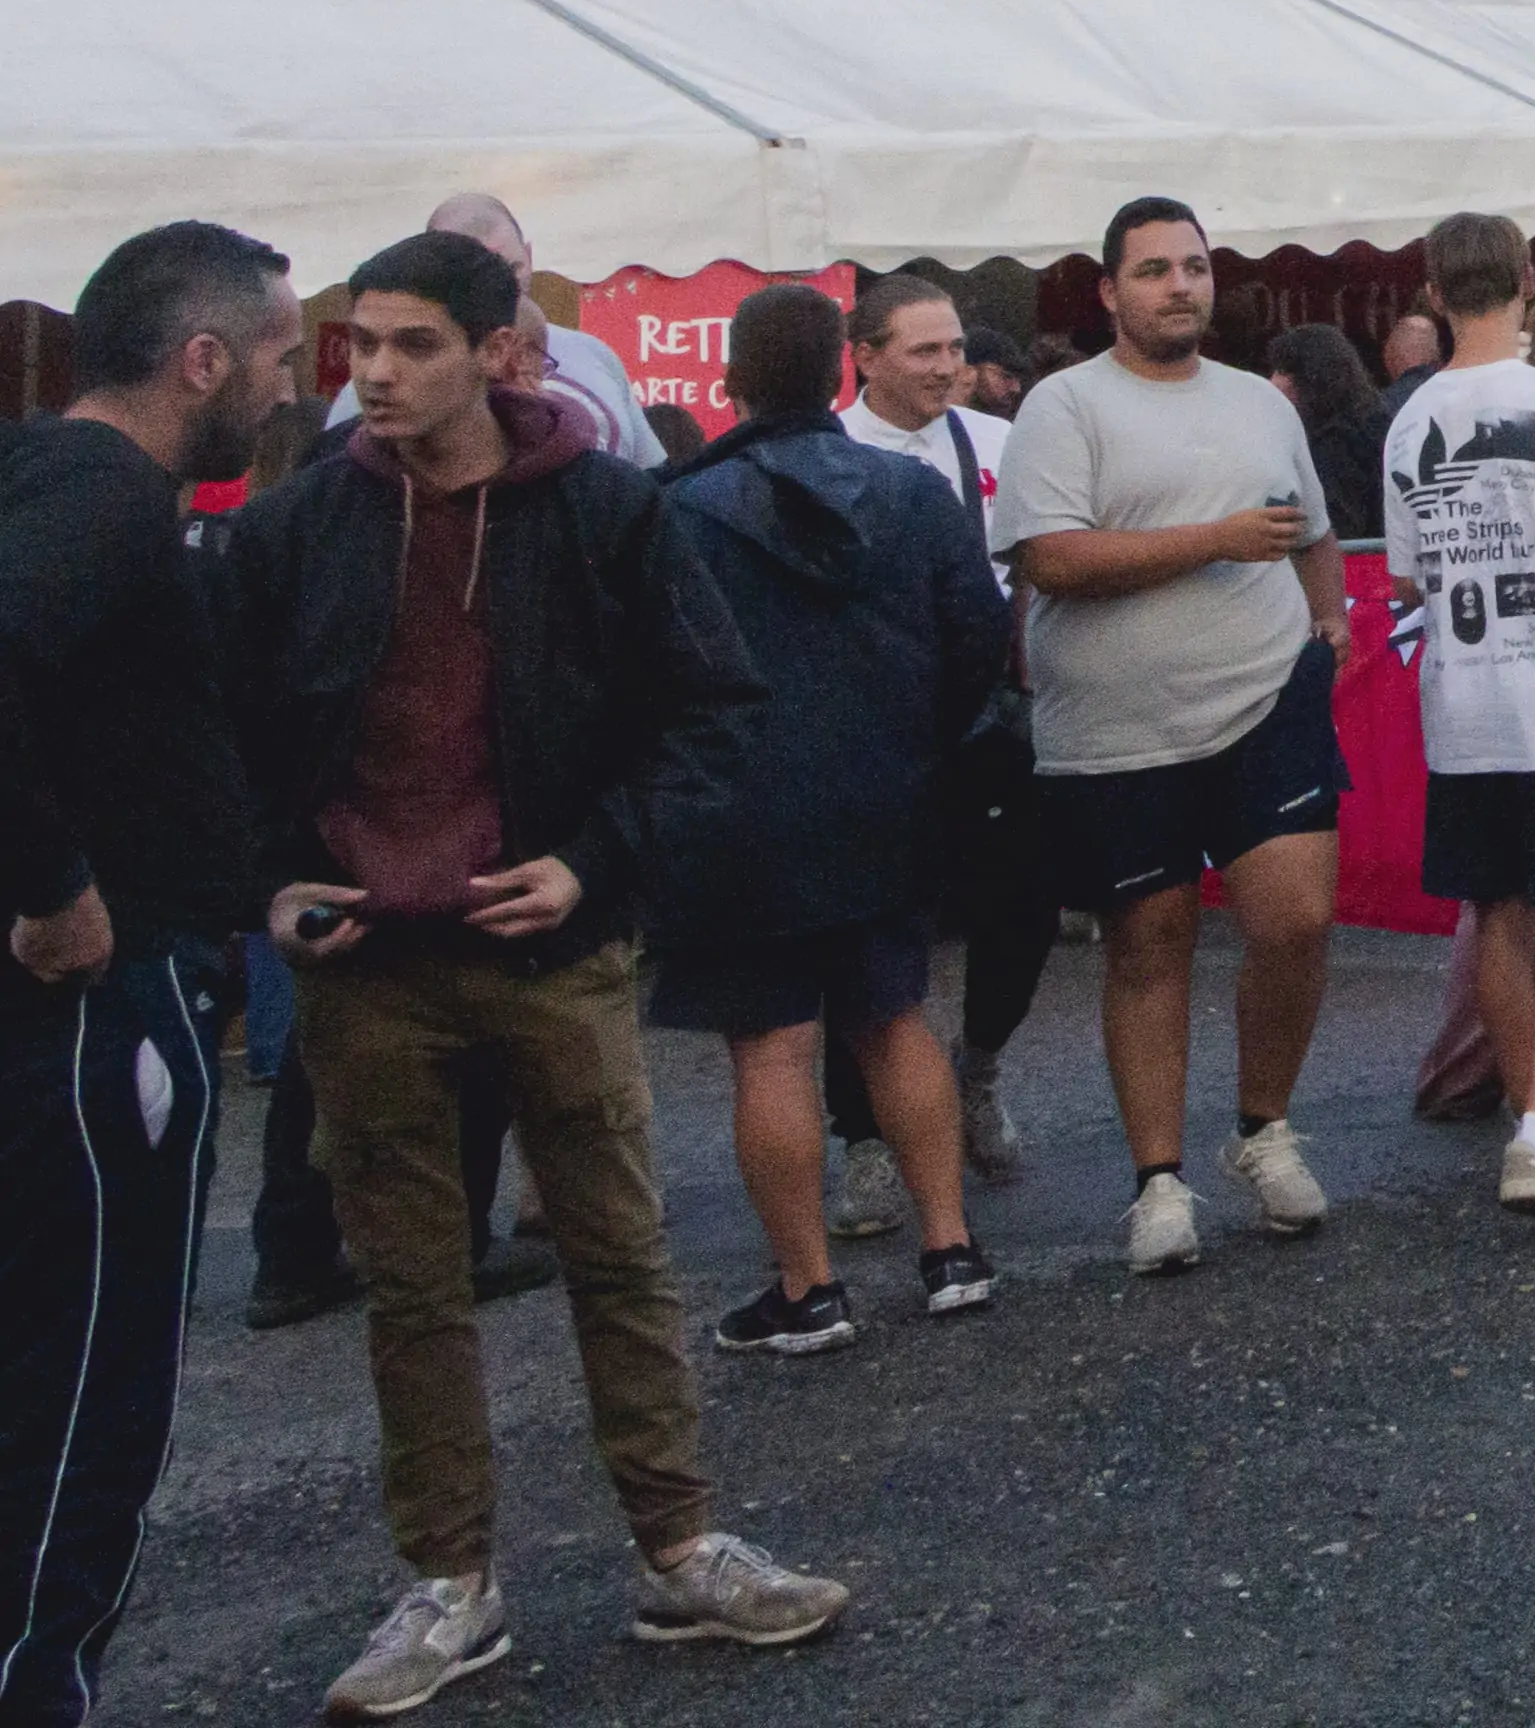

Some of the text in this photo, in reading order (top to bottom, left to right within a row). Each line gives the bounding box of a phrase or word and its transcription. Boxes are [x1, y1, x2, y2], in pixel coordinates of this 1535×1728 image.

[637, 314, 732, 364] RET
[628, 377, 699, 406] ARTE
[1443, 499, 1482, 518] The
[1420, 527, 1460, 546] hree
[1446, 540, 1503, 565] World
